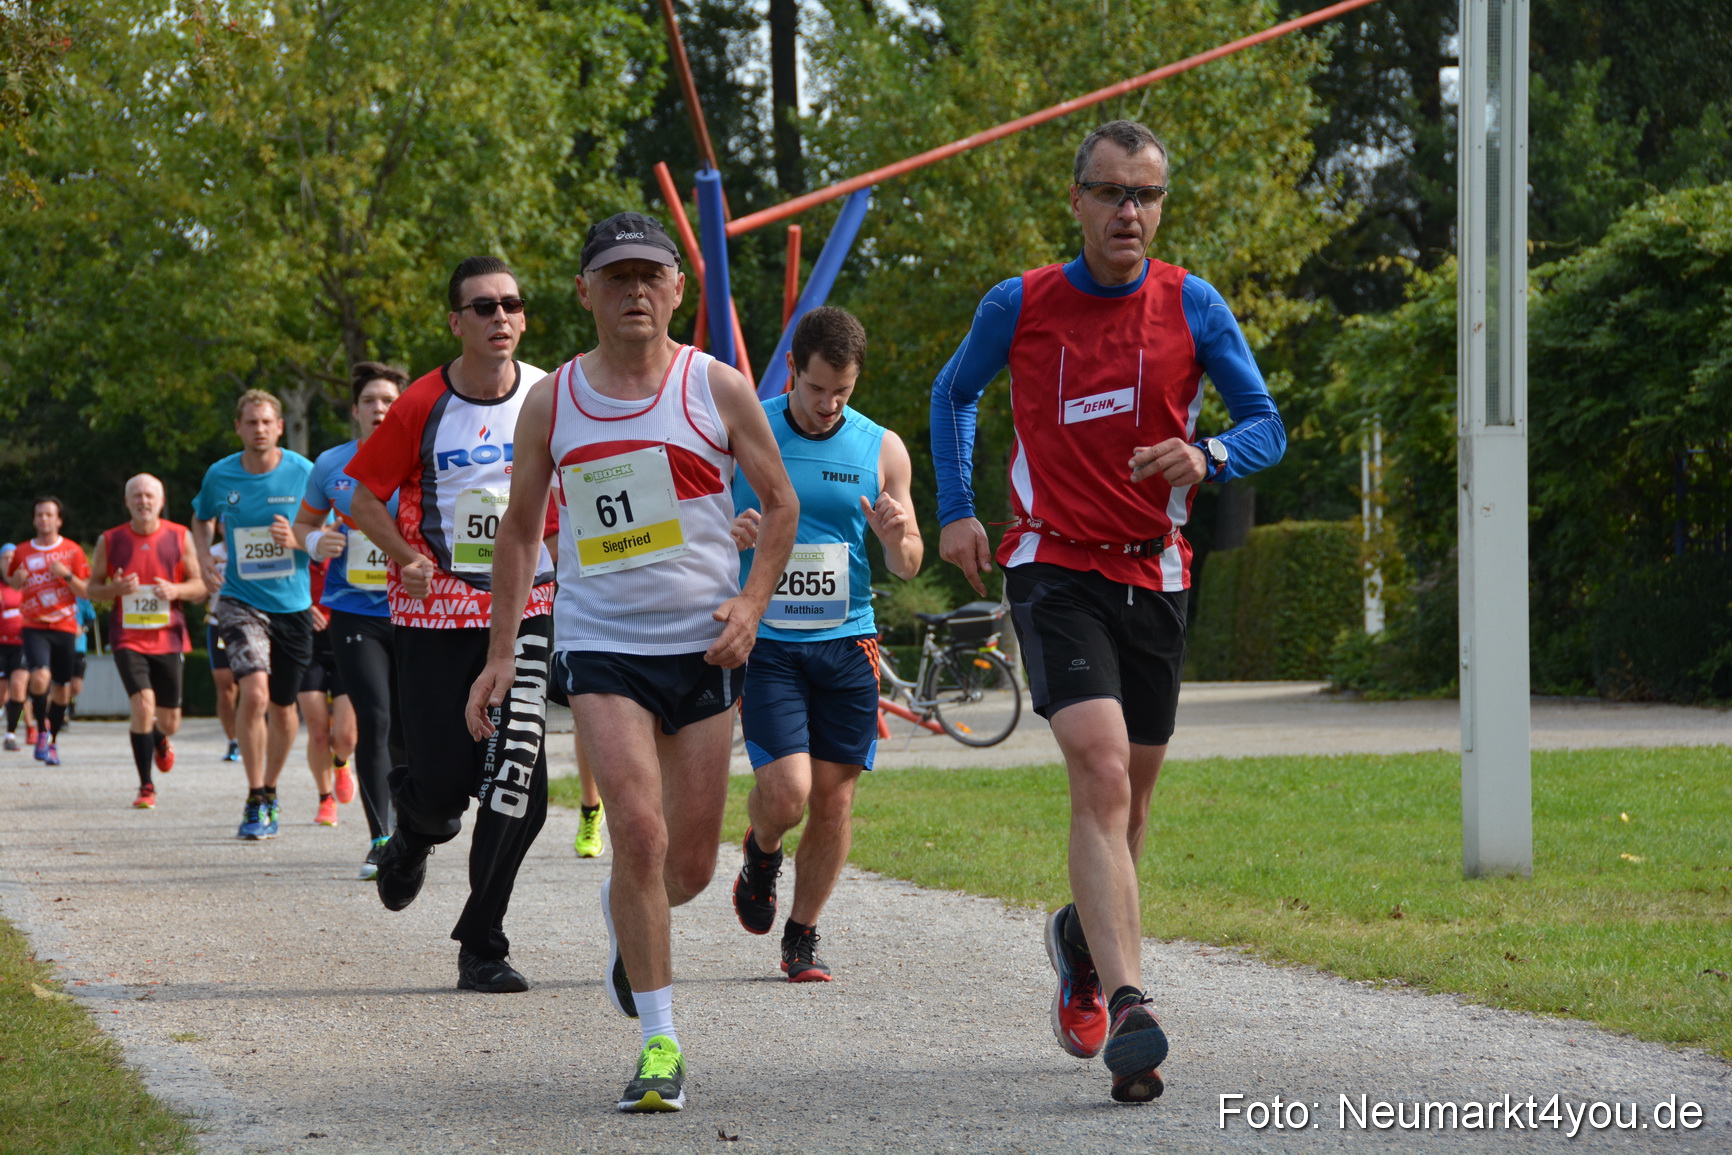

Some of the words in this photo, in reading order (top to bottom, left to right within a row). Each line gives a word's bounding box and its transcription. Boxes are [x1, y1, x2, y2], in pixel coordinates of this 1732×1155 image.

[1083, 398, 1115, 413] DEHN
[593, 464, 635, 481] BOCK
[822, 471, 860, 484] THULE
[596, 490, 634, 528] 61
[602, 532, 651, 553] Siegfried
[244, 543, 284, 559] 2595
[773, 571, 836, 596] 2655
[135, 598, 158, 612] 128
[784, 604, 824, 615] Matthias
[484, 729, 499, 772] SINCE
